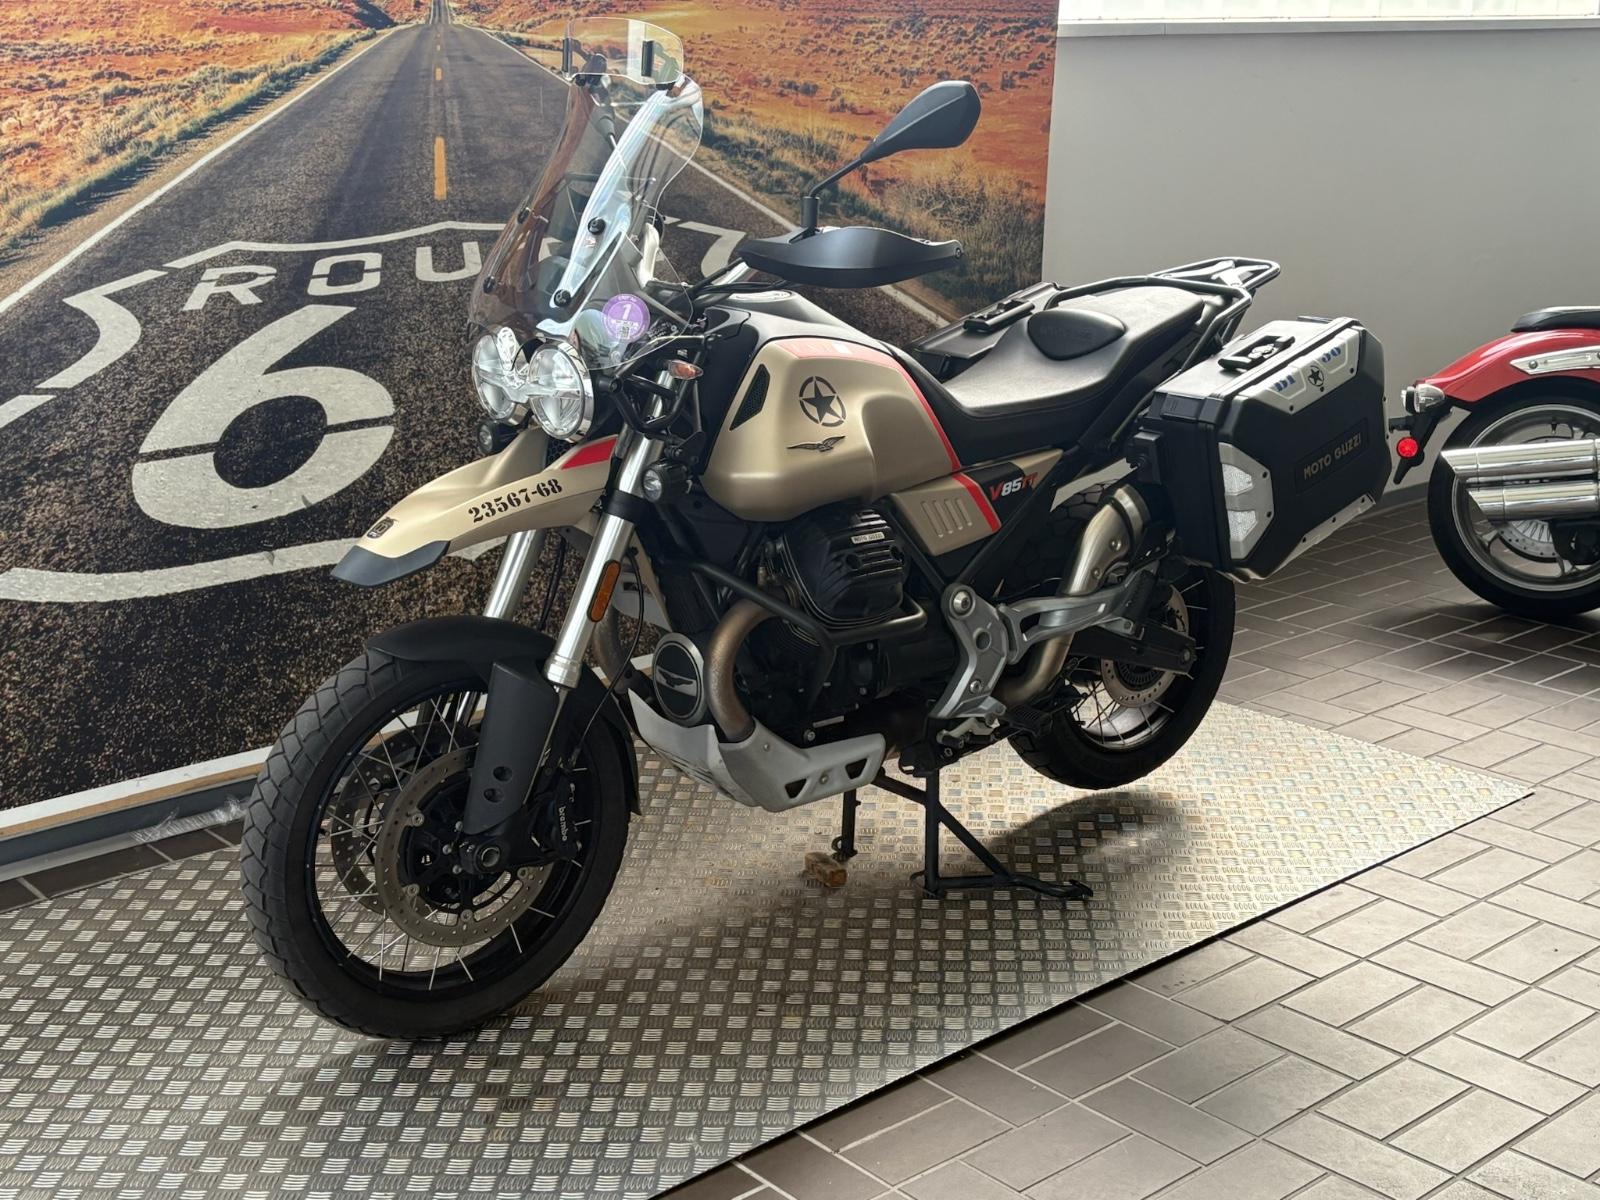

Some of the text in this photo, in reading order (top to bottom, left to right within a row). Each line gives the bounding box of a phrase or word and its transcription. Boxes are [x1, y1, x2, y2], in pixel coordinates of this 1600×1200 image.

[131, 304, 395, 530] 6
[1303, 432, 1361, 480] MOTO GUZZI
[468, 478, 563, 523] 23567-68
[558, 805, 569, 842] brembo
